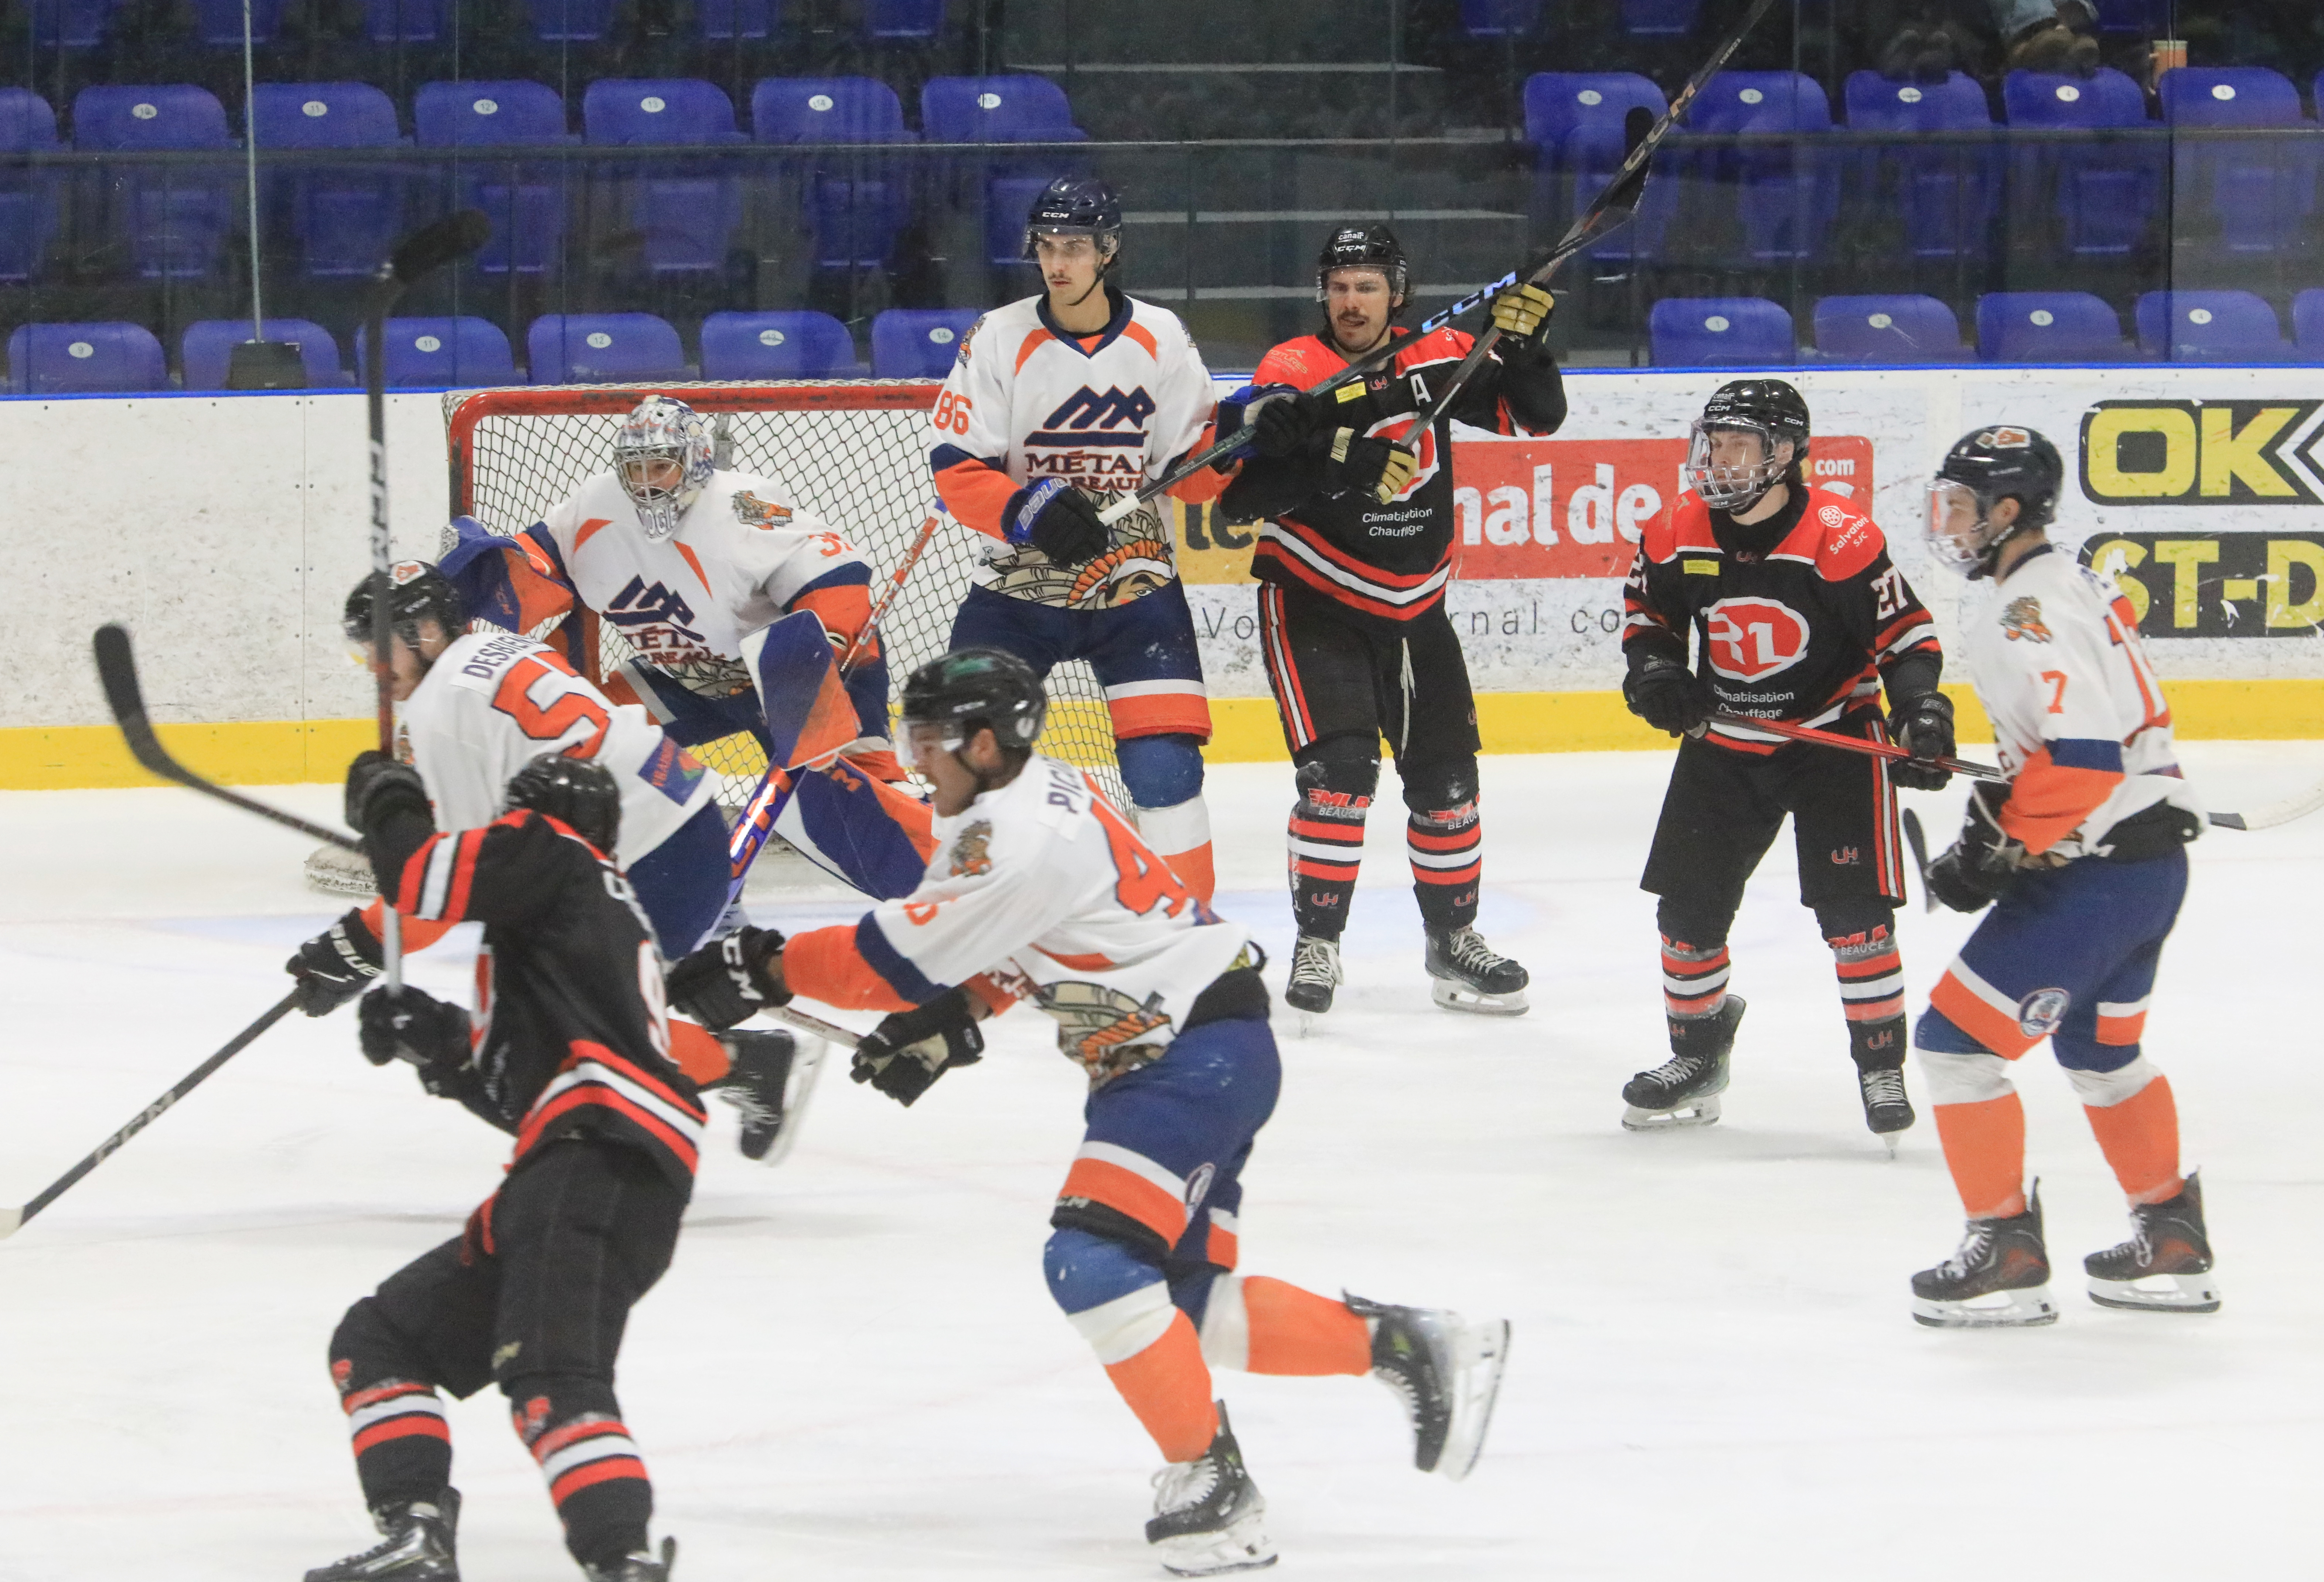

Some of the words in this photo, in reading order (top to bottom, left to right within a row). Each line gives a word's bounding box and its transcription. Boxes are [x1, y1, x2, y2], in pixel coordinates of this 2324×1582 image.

[1338, 232, 1364, 240] canair
[1410, 373, 1432, 406] A
[934, 391, 972, 435] 86
[1784, 417, 1804, 426] CCM
[1025, 450, 1144, 475] MÉTA
[2088, 408, 2300, 497] OK
[1568, 462, 1662, 545] de
[1853, 531, 1868, 547] SJC
[1870, 565, 1909, 620] 27
